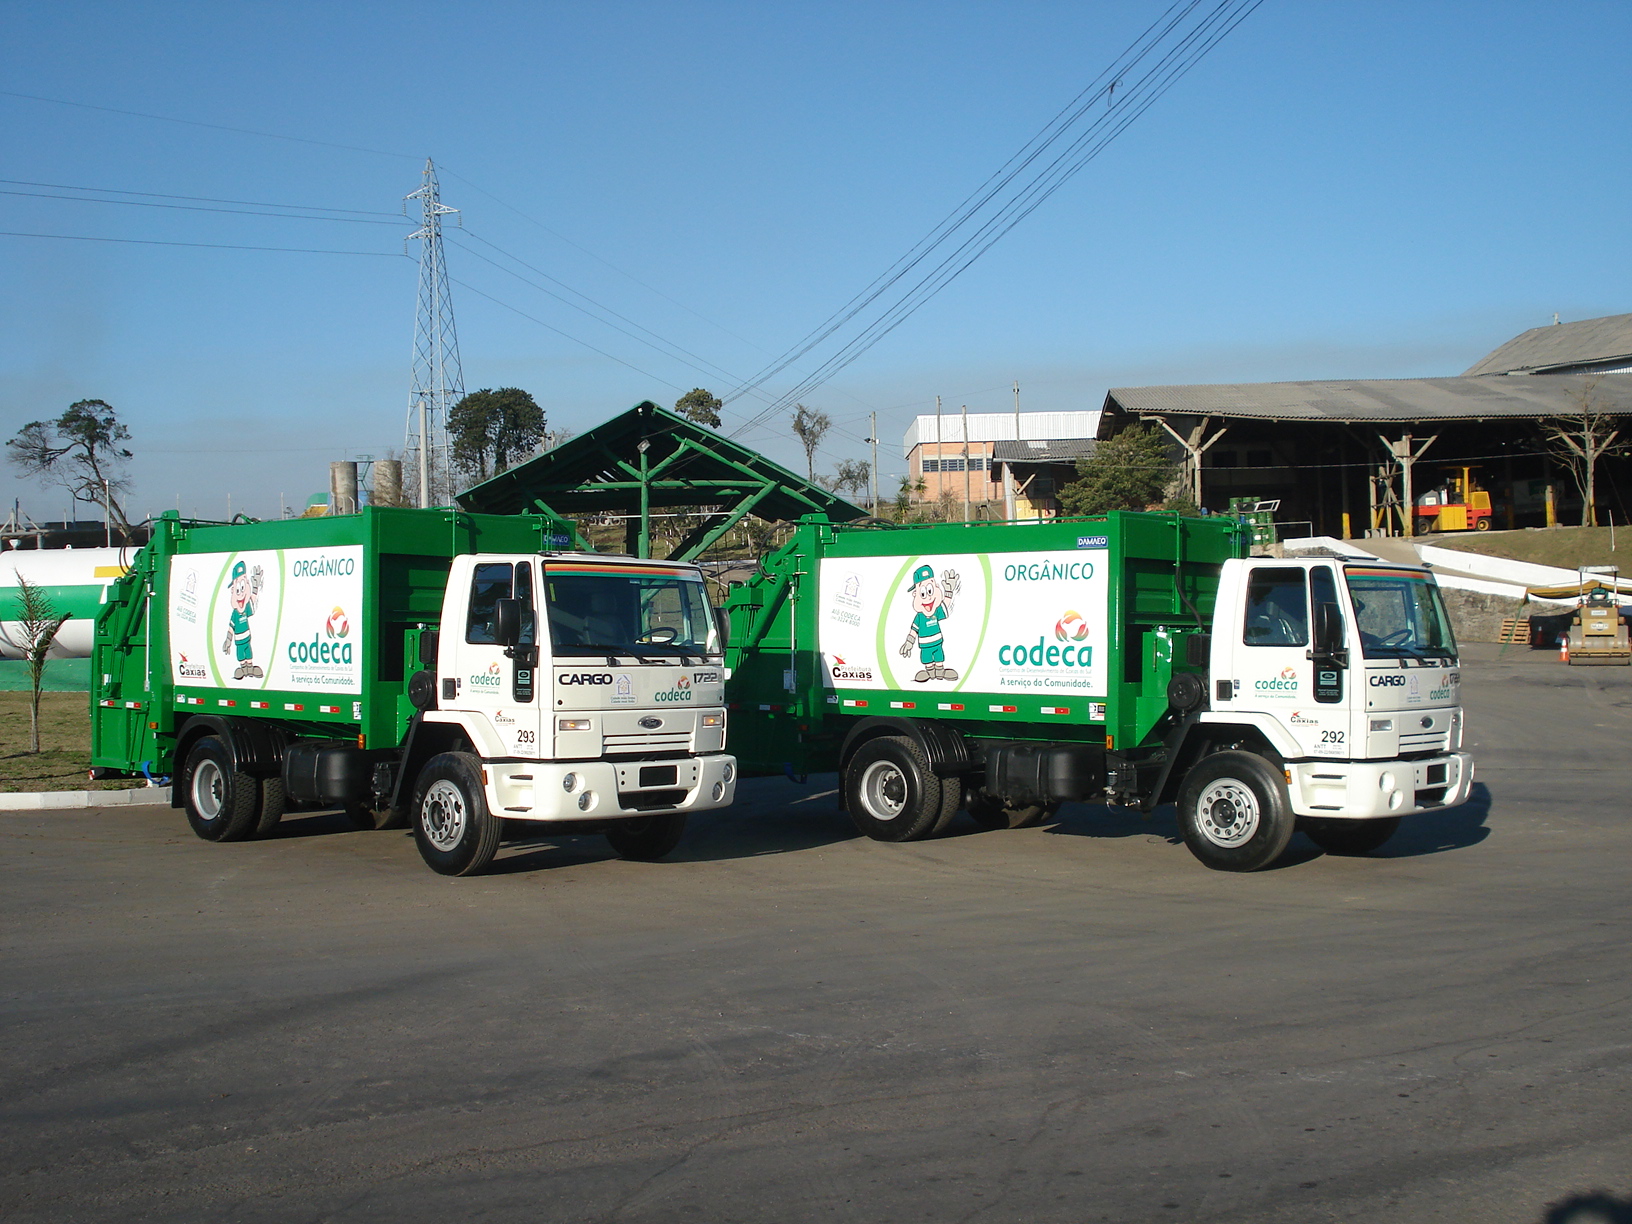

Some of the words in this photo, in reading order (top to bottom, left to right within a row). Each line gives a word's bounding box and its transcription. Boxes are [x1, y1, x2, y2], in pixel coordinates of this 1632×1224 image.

[293, 555, 355, 577] ORGÂNICO
[1004, 559, 1094, 581] ORGÂNICO
[840, 610, 861, 622] CODECA
[288, 632, 353, 664] codeca
[998, 635, 1093, 667] codeca
[179, 664, 206, 676] Caxias
[832, 666, 872, 679] Caxias
[296, 675, 313, 686] serviço
[470, 672, 500, 686] codeca
[558, 673, 613, 685] CARGO
[1000, 677, 1005, 686] A
[1007, 678, 1031, 688] serviço
[1033, 678, 1042, 687] da
[1044, 678, 1093, 688] Comunidade.
[1255, 677, 1298, 690] codeca
[1369, 675, 1405, 687] CARGO
[654, 687, 692, 702] codeca
[1429, 685, 1450, 700] codeca
[495, 715, 515, 723] Caxias
[1290, 716, 1319, 724] Caxias
[517, 729, 535, 744] 293
[1321, 730, 1345, 744] 292
